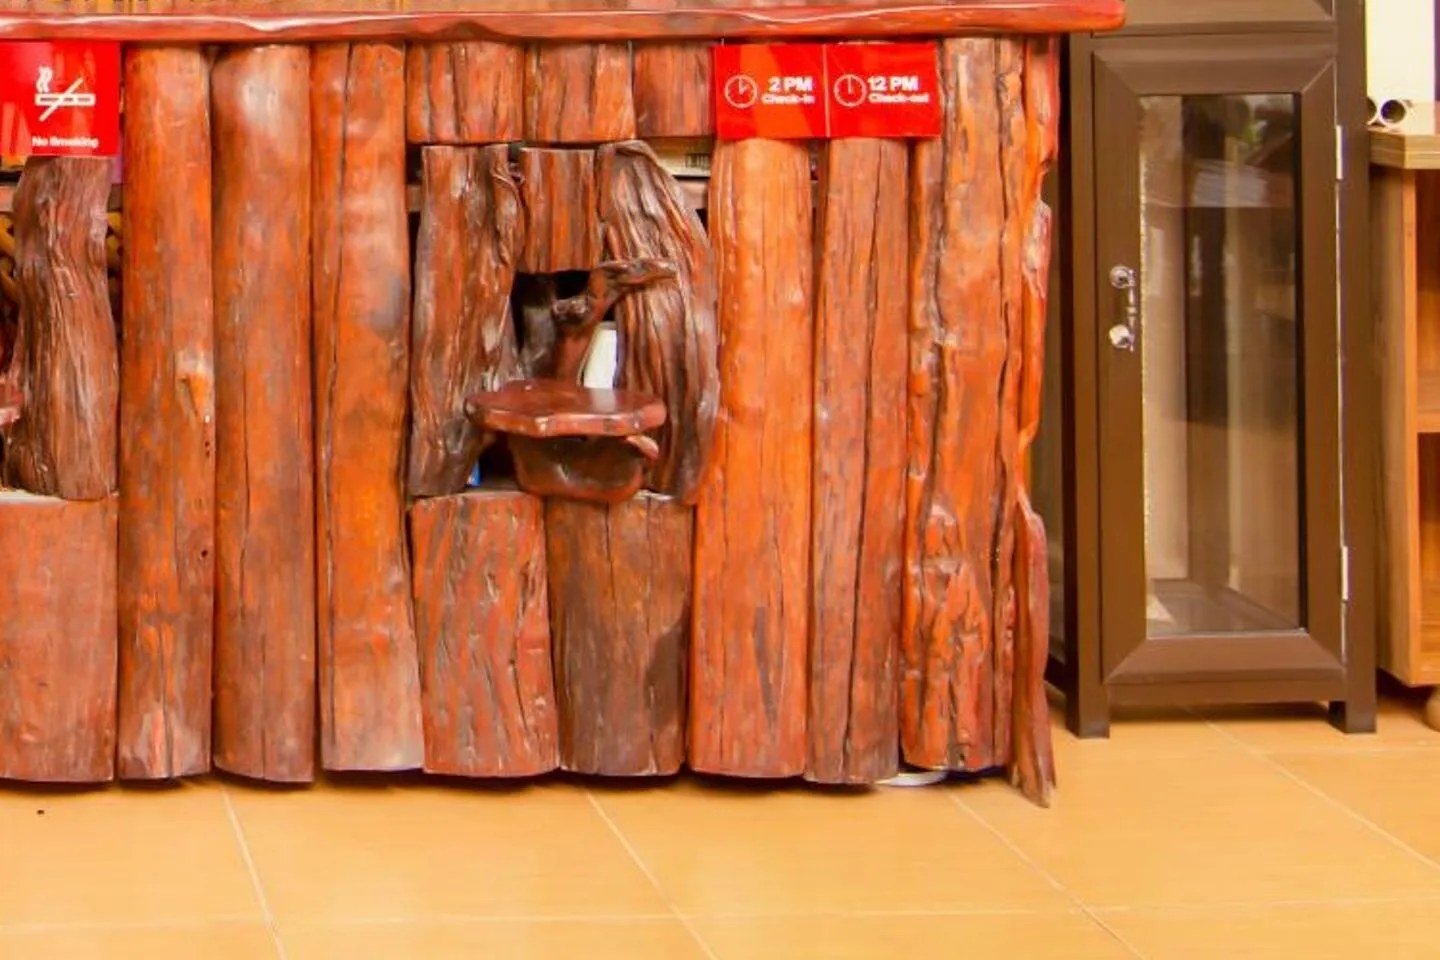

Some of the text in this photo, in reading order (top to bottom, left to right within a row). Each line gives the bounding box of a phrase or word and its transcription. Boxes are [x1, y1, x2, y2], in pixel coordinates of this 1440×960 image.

[768, 76, 813, 91] 2 PM
[867, 76, 919, 91] 12 PM
